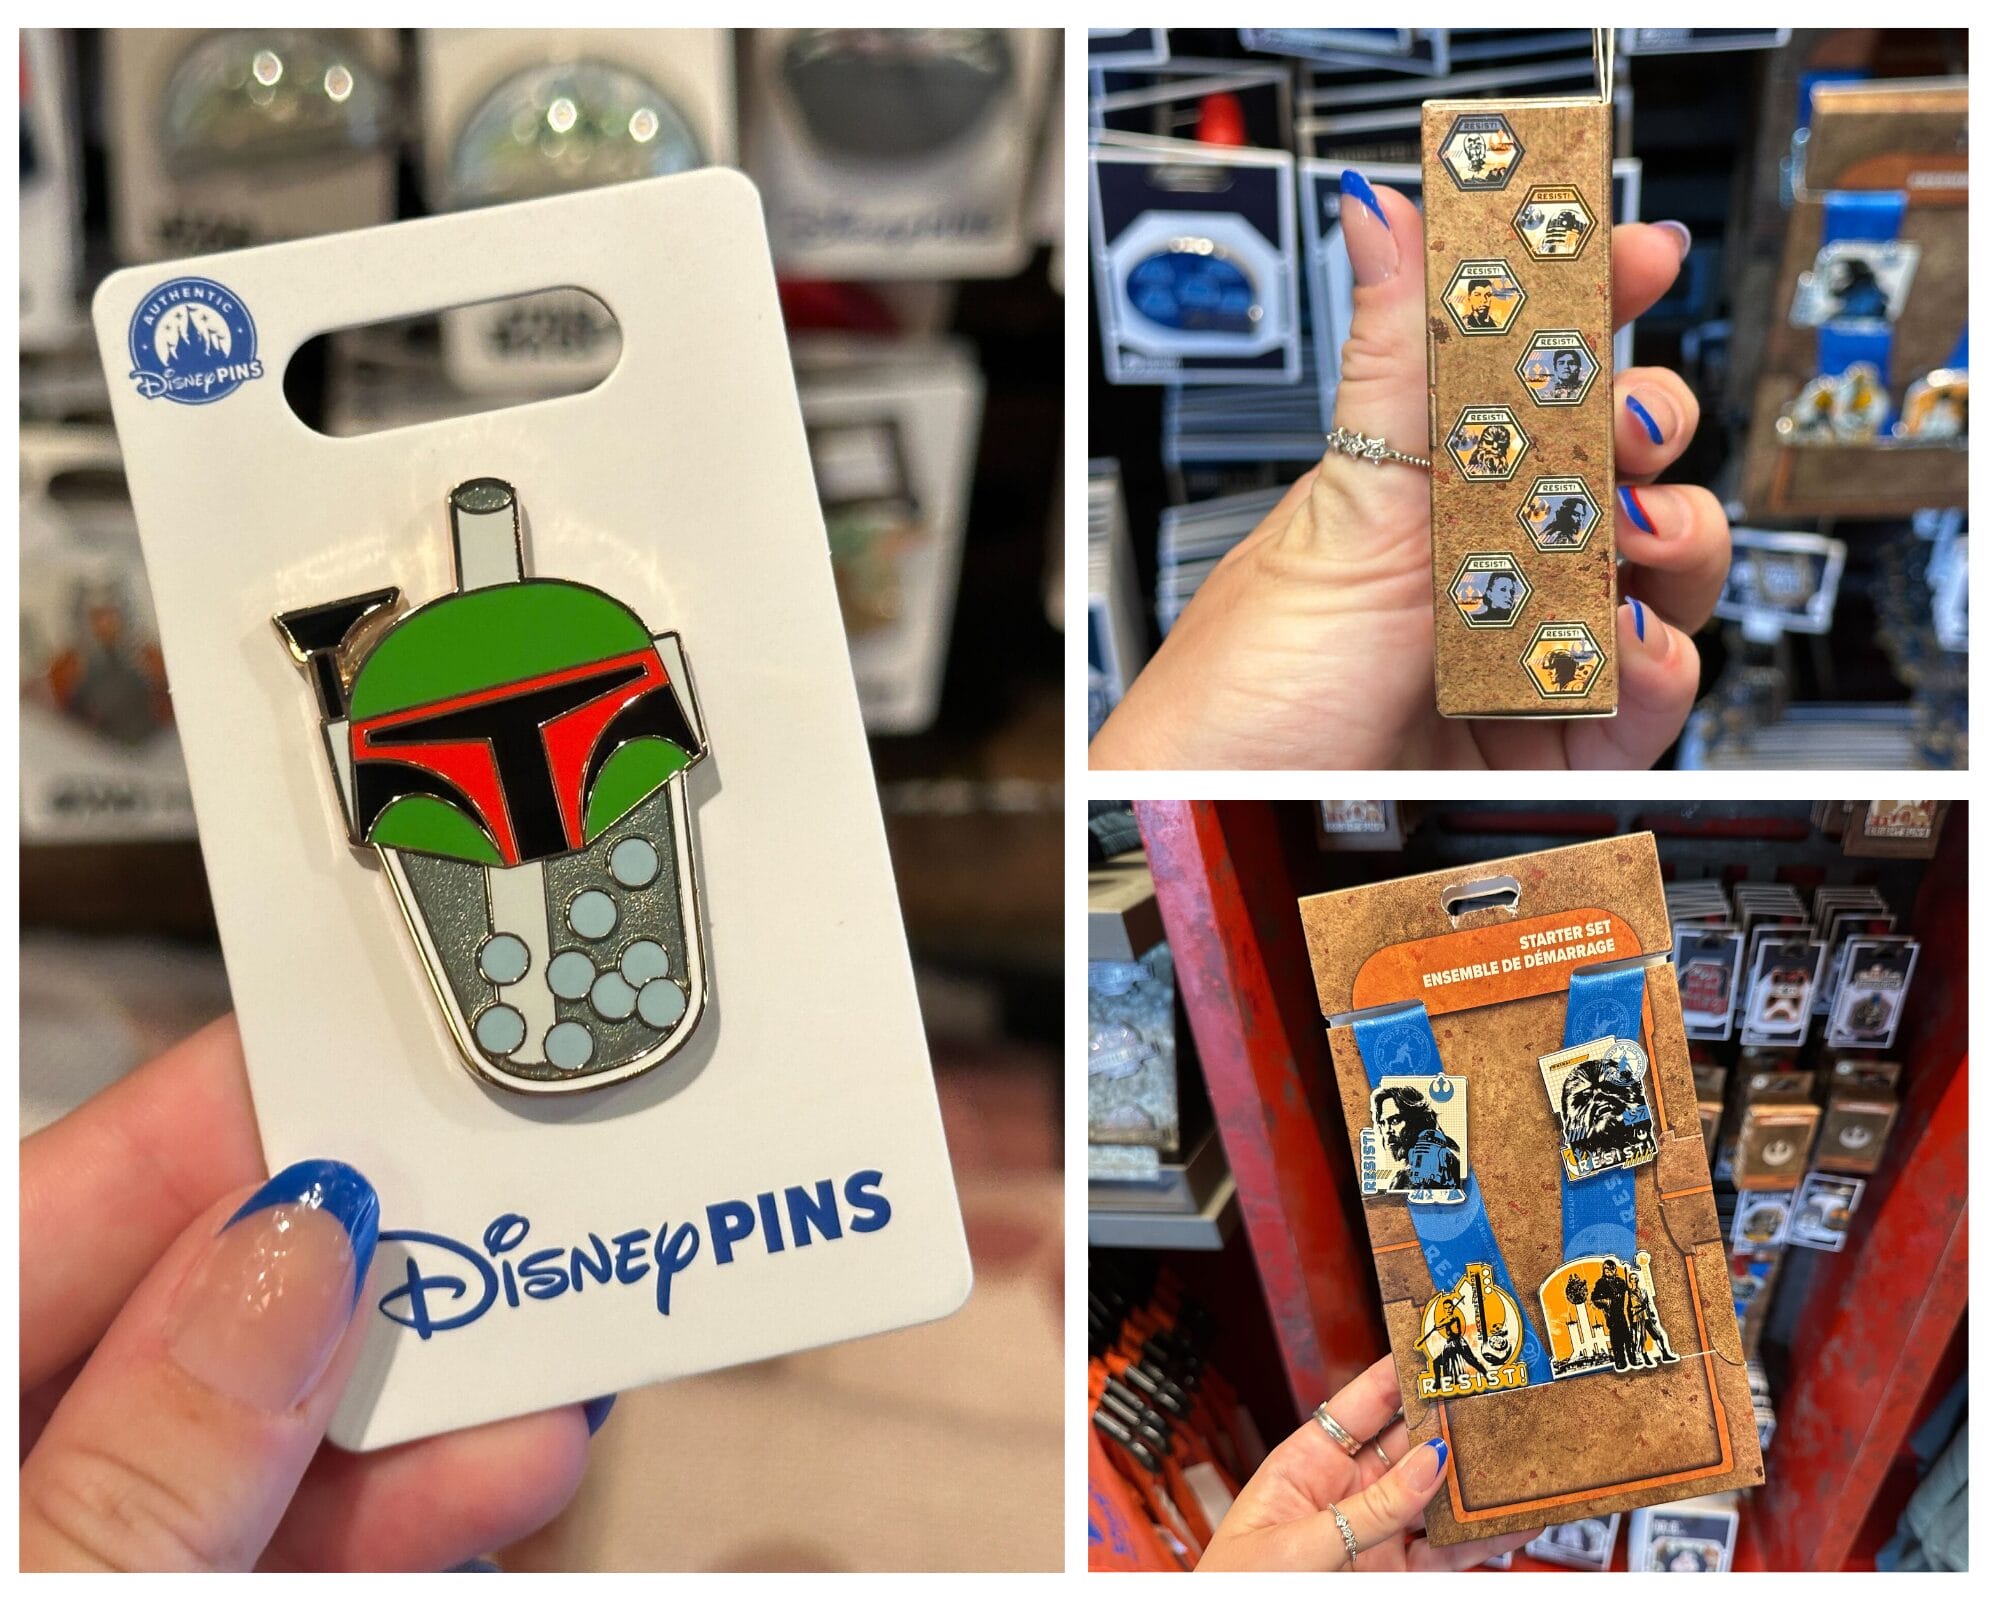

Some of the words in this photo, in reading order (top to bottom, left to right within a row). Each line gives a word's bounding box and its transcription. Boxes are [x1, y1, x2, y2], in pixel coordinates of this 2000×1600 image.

[1464, 122, 1498, 130] RESIST!
[1537, 192, 1571, 200] RESIST!
[1466, 267, 1501, 275] RESIST!
[142, 287, 233, 326] AUTHENTIC
[1540, 338, 1575, 346] RESIST!
[132, 368, 216, 397] Disney
[216, 361, 263, 384] PINS
[1542, 484, 1577, 492] RESIST!
[1546, 630, 1580, 638] RESIST!
[1519, 925, 1583, 950] STARTER
[1585, 919, 1612, 937] SET
[1422, 961, 1500, 988] ENSEMBLE
[1501, 957, 1521, 973] DE
[1524, 938, 1616, 968] DÉMARRAGE
[1578, 1141, 1654, 1173] RESIST!
[378, 1213, 700, 1340] Disney
[705, 1170, 892, 1265] PINS
[1422, 1366, 1527, 1394] RESIST!
